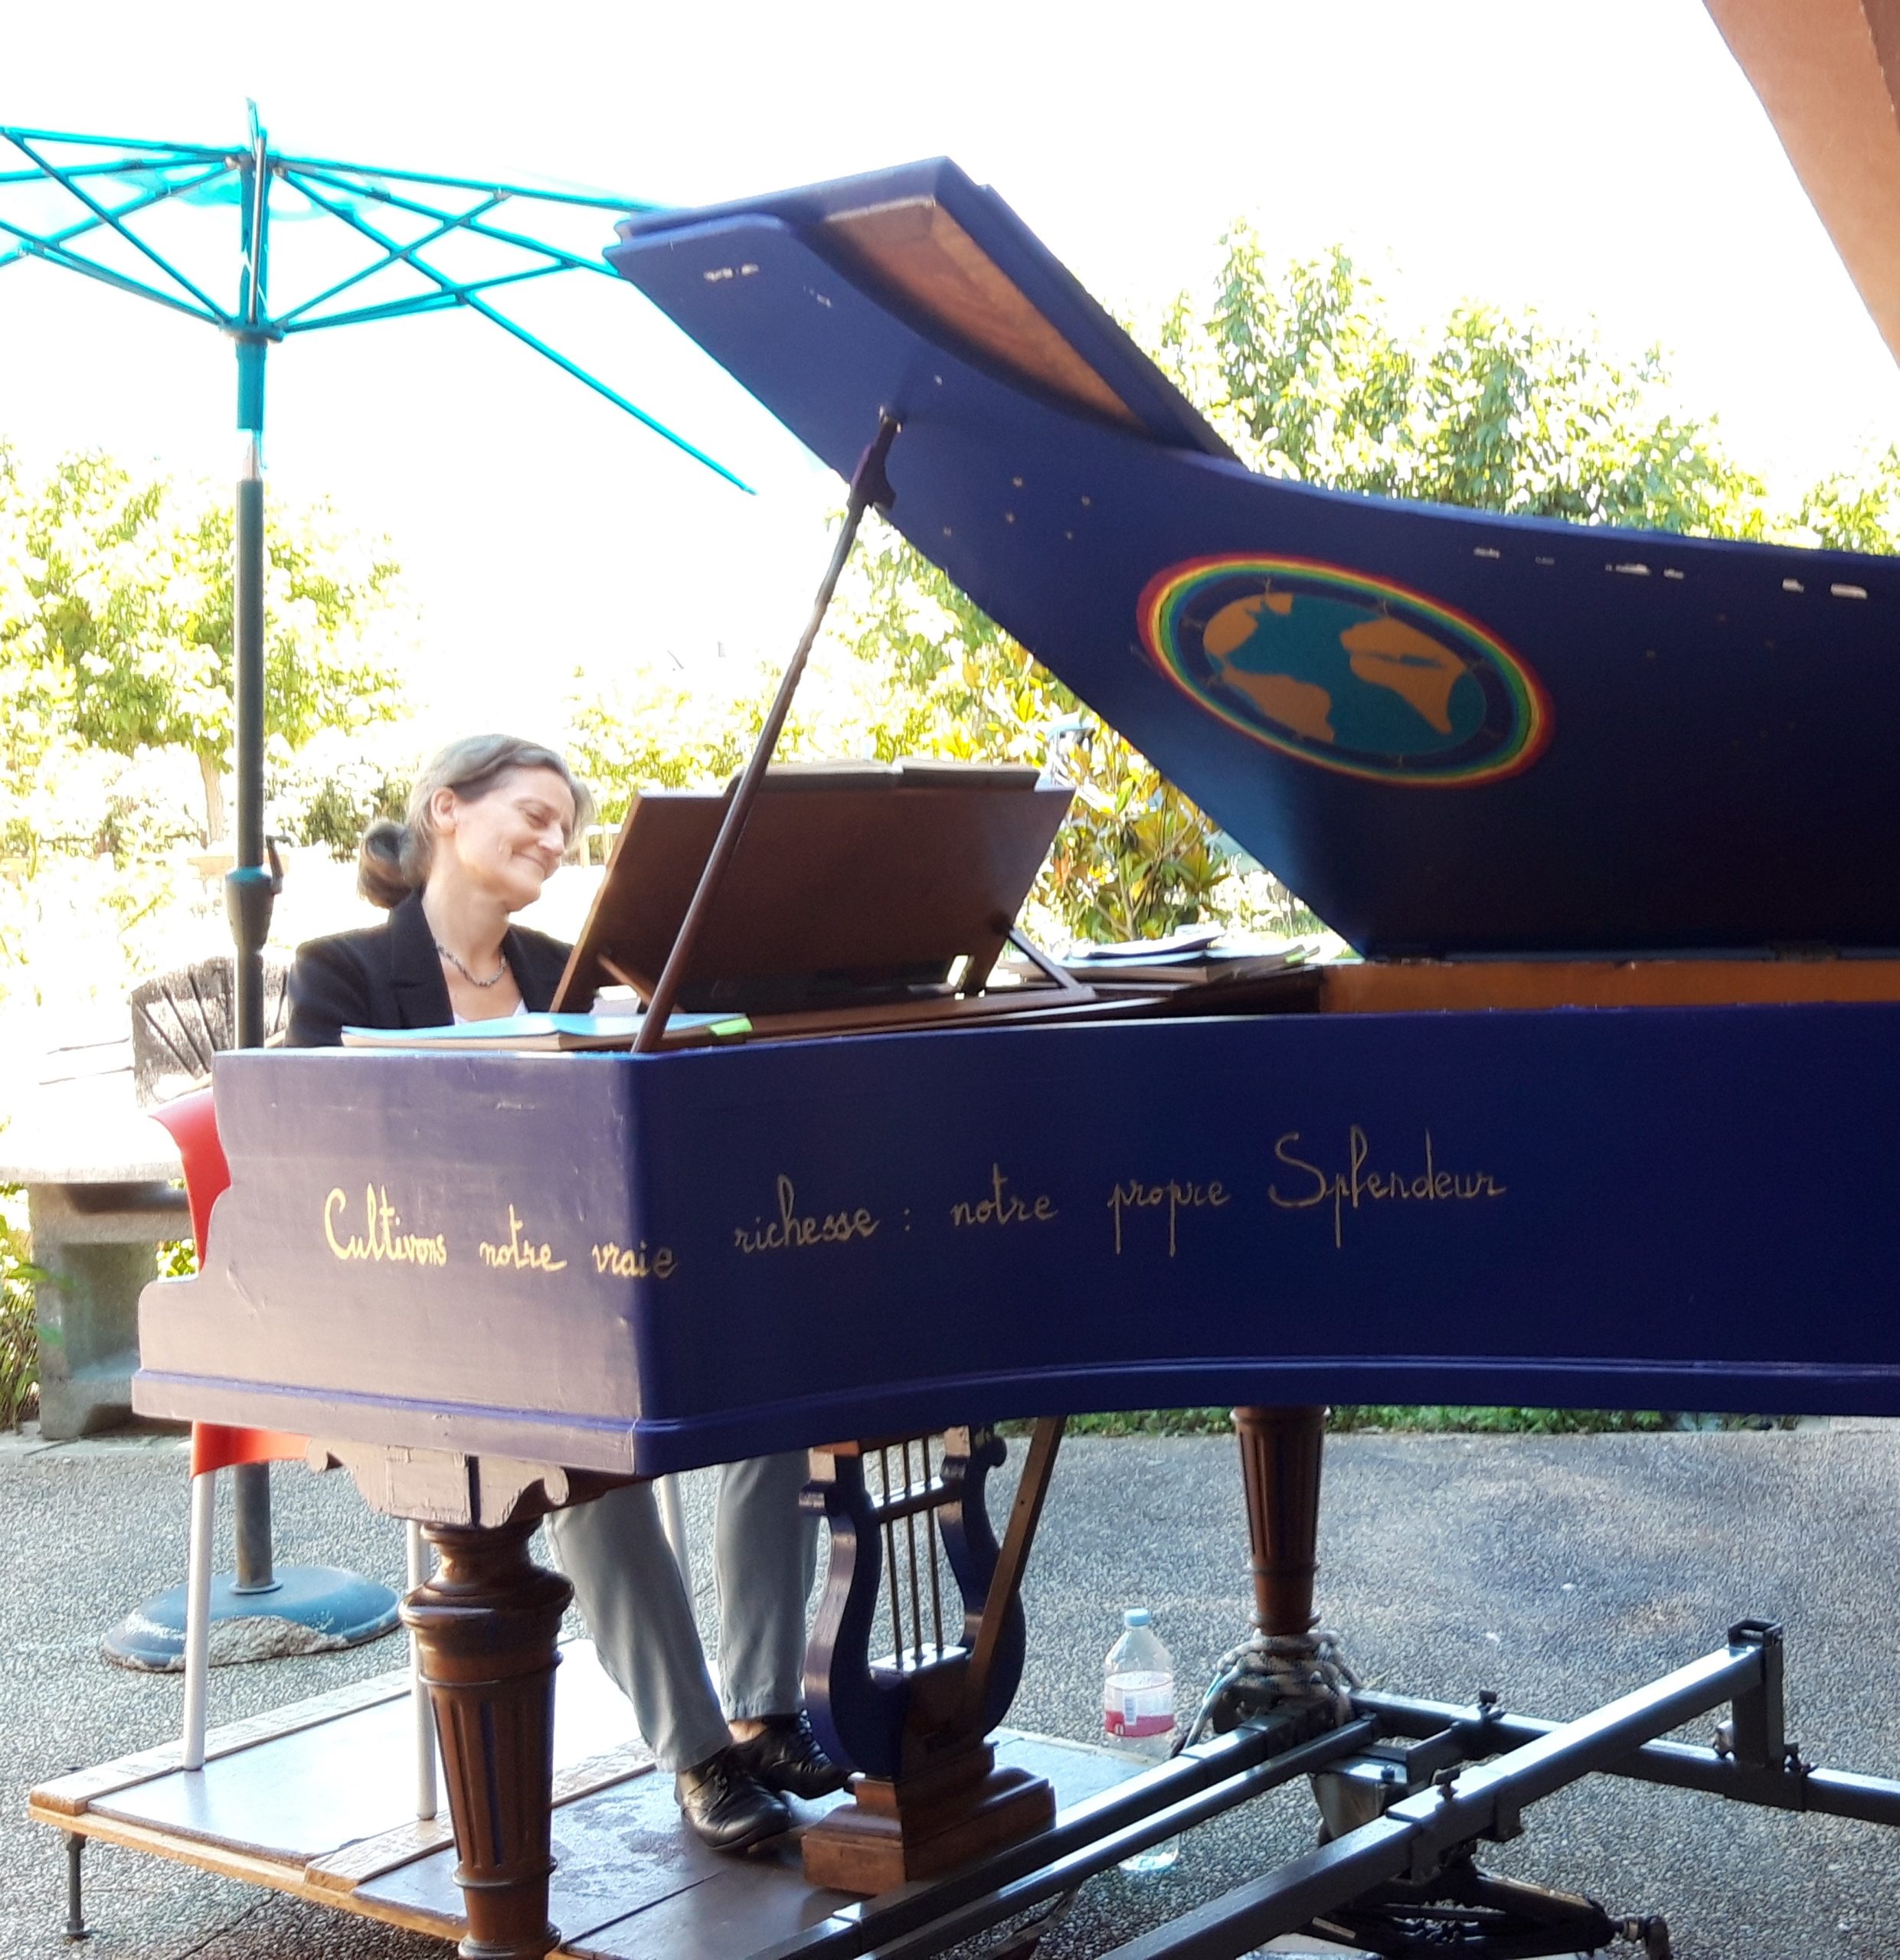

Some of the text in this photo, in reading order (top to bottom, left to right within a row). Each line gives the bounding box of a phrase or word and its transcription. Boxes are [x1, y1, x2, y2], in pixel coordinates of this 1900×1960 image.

[325, 1182, 447, 1268] Cultivons
[479, 1204, 567, 1272] notre
[591, 1241, 678, 1279] vraie
[734, 1174, 878, 1254] richesse
[950, 1163, 1059, 1227] notre
[1107, 1177, 1231, 1256] propre
[1267, 1124, 1506, 1250] Splendeur
